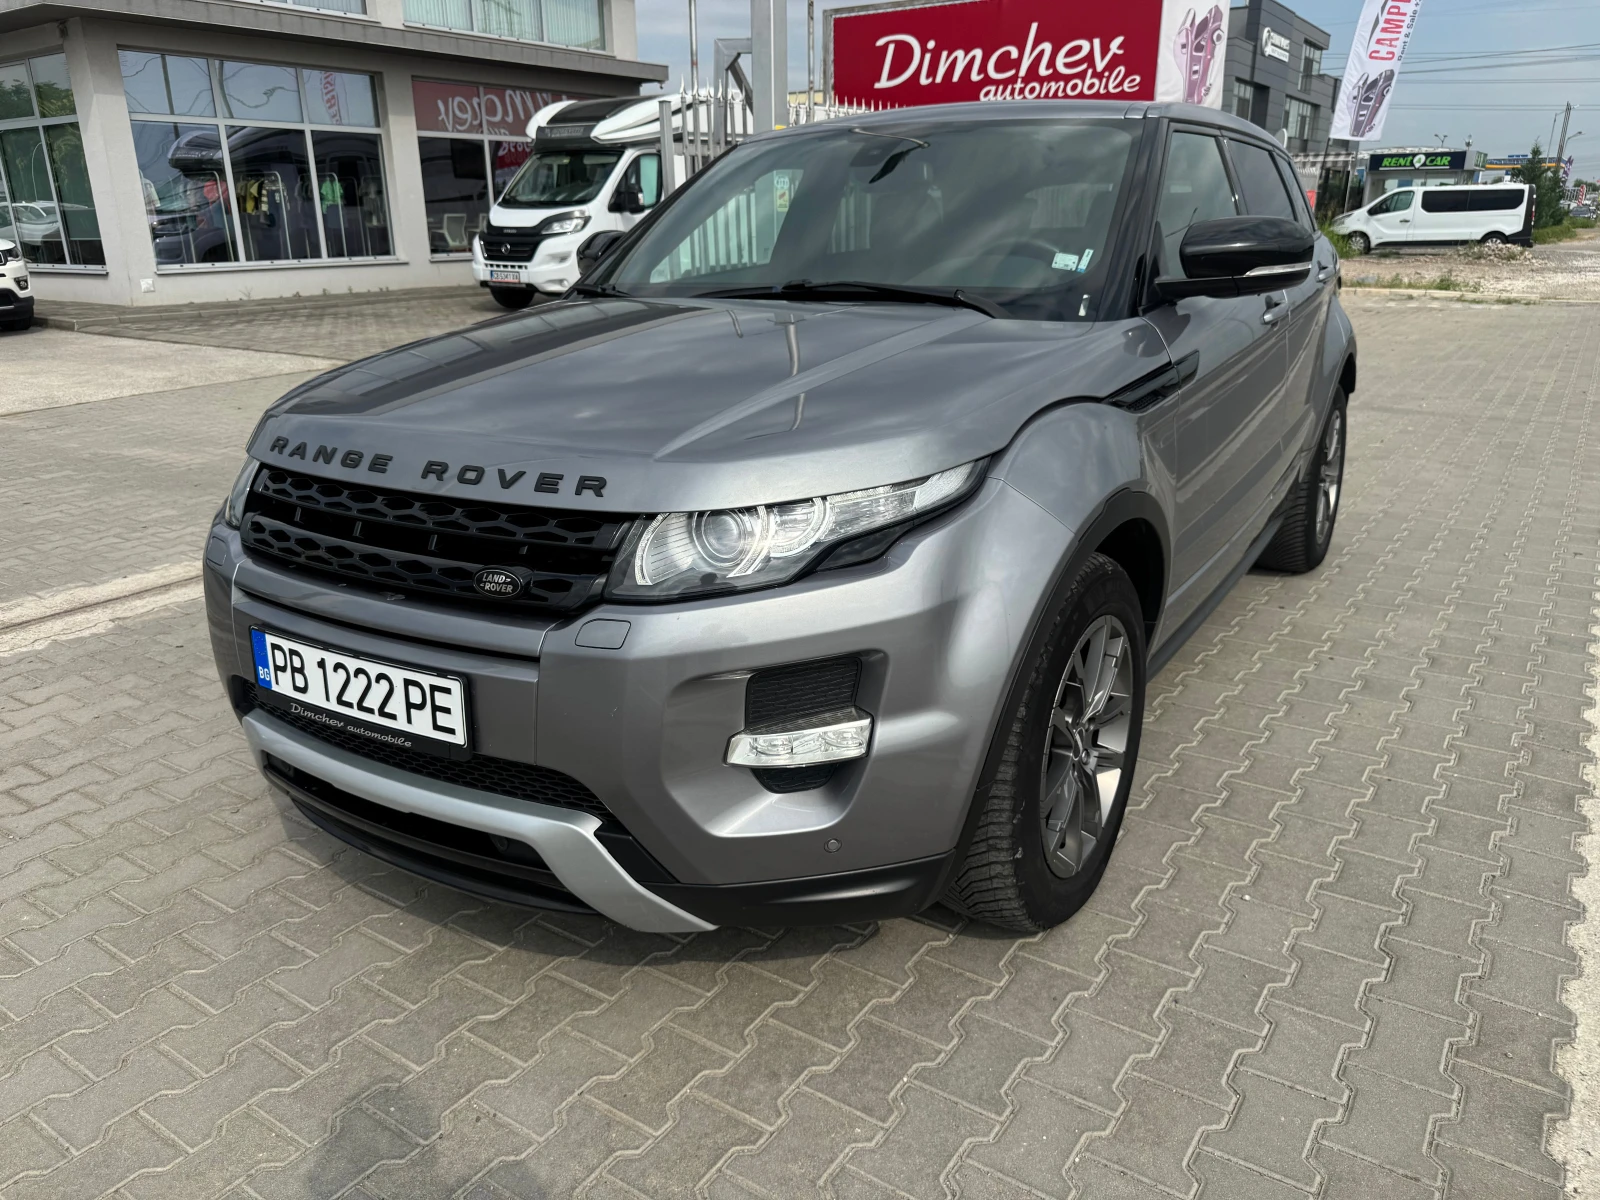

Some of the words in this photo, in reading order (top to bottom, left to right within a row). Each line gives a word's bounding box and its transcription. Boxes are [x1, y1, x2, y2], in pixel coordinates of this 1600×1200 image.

[1406, 9, 1418, 29] Sale
[874, 22, 1125, 89] Dimchev
[979, 66, 1141, 101] automobile
[1426, 156, 1451, 166] CAR
[270, 435, 393, 473] RANGE
[421, 460, 608, 497] ROVER
[483, 573, 505, 583] LAND
[484, 582, 513, 593] ROVER
[258, 666, 270, 681] BG
[270, 642, 309, 695] PB
[317, 657, 398, 721] 1222
[403, 677, 456, 736] PE
[290, 702, 344, 728] Dimchev
[347, 724, 412, 748] automobile
